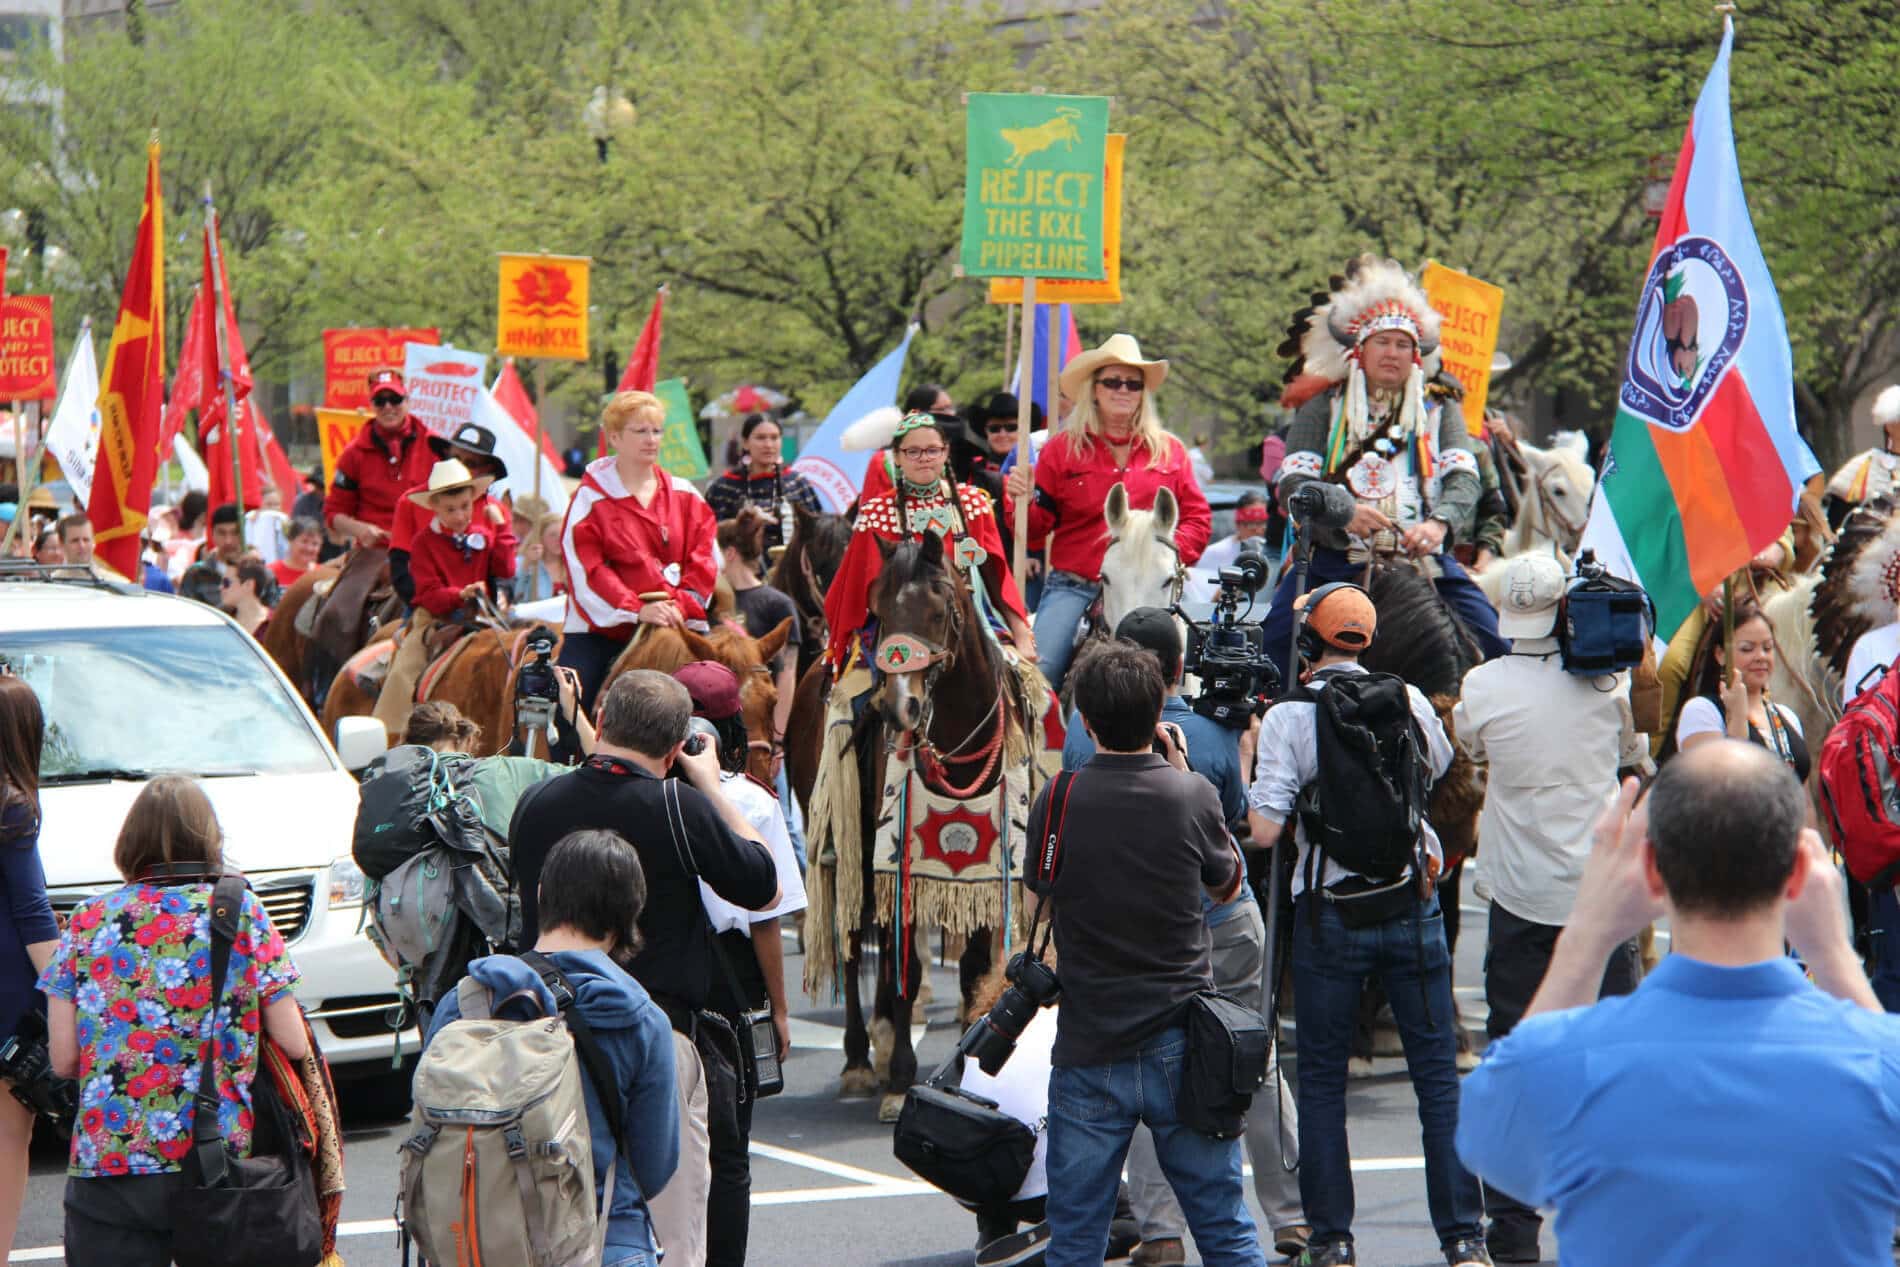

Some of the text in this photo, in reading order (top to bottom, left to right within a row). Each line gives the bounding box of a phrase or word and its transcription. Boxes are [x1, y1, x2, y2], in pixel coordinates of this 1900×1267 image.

[980, 168, 1094, 208] REJECT
[985, 208, 1087, 240] THE KXL
[979, 240, 1089, 272] PIPELINE
[334, 346, 382, 364] REJECT
[409, 376, 479, 404] PROTECT
[1044, 834, 1057, 871] Canon
